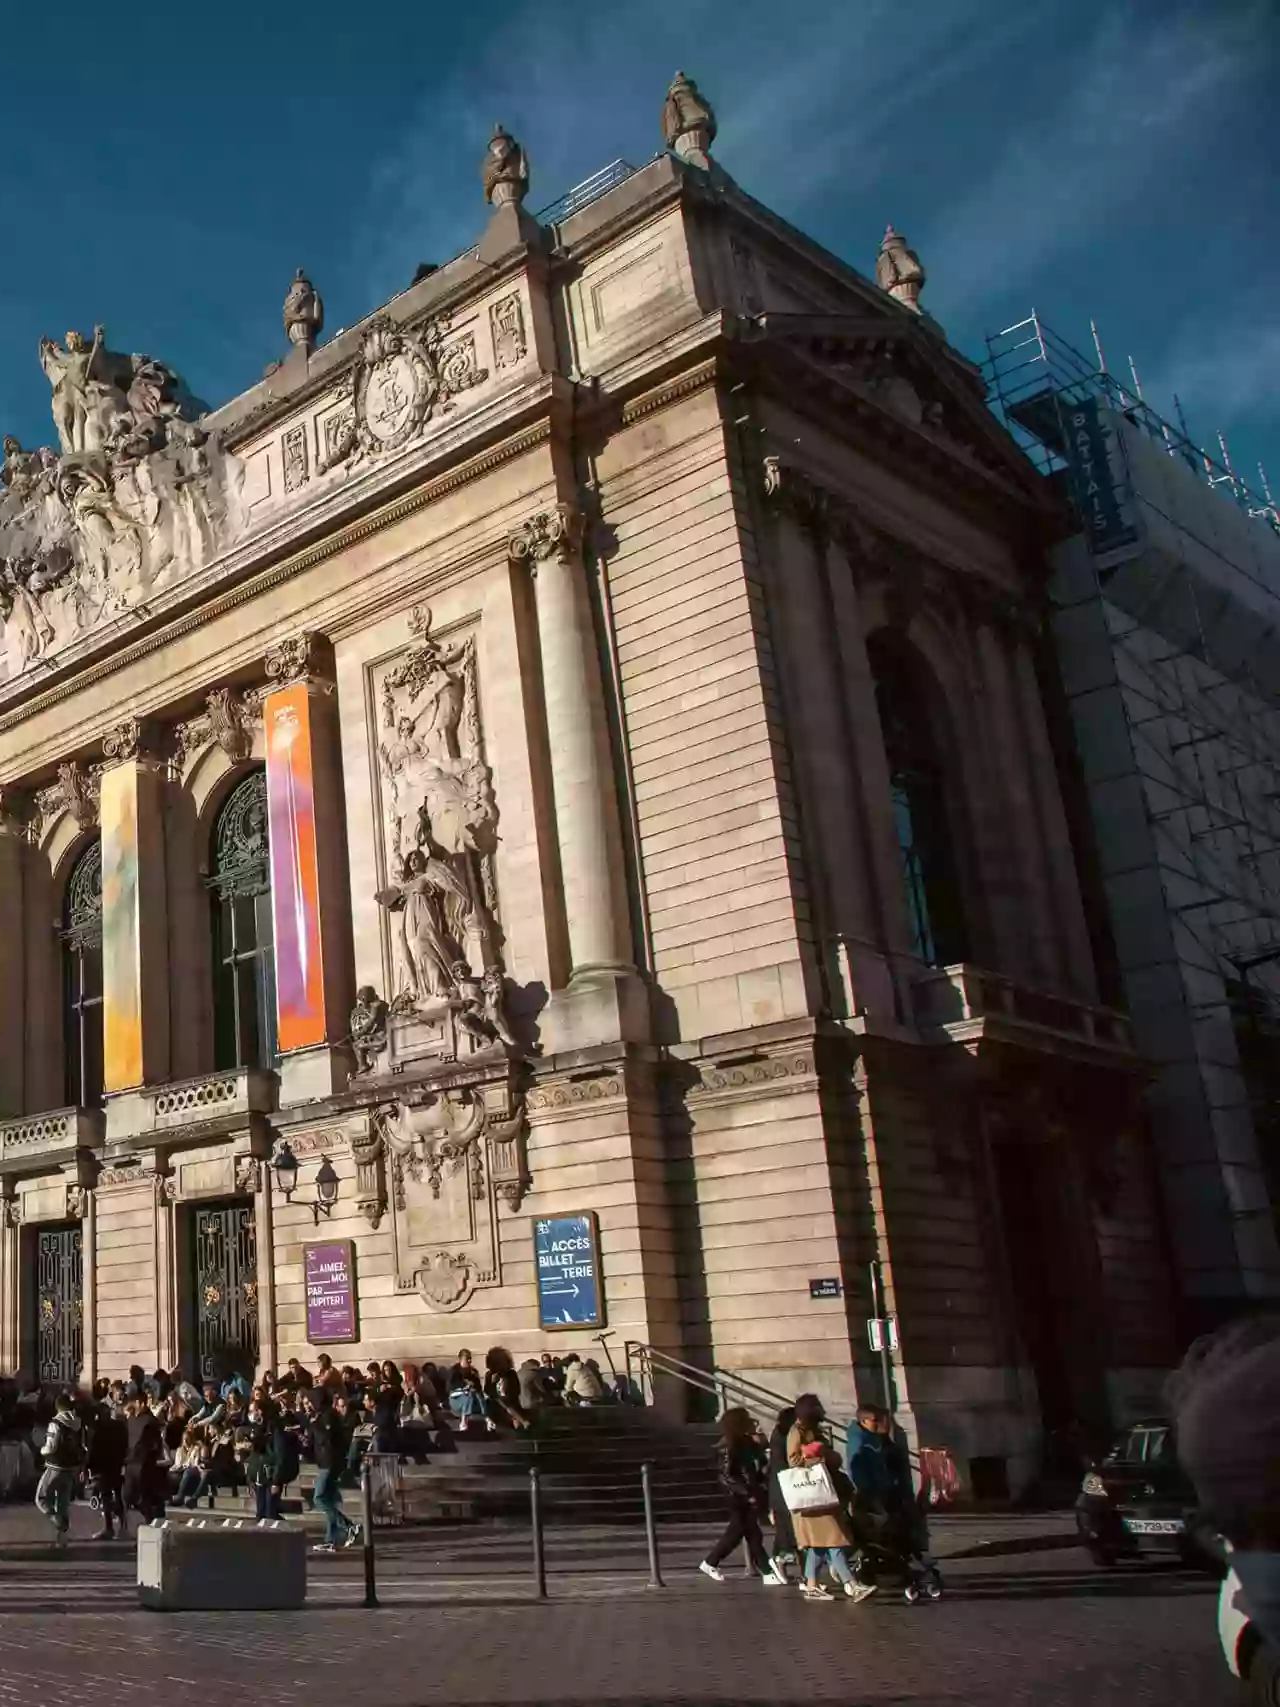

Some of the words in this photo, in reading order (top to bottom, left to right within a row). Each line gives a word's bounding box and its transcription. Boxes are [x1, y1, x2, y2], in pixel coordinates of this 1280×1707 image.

[1073, 413, 1107, 529] BATTAIS
[551, 1236, 590, 1252] ACCÈS
[320, 1262, 347, 1272] AIMEZ-
[539, 1254, 573, 1267] BILLET
[331, 1273, 348, 1283] MOI
[562, 1265, 593, 1279] TERIE
[307, 1287, 323, 1296] PAR
